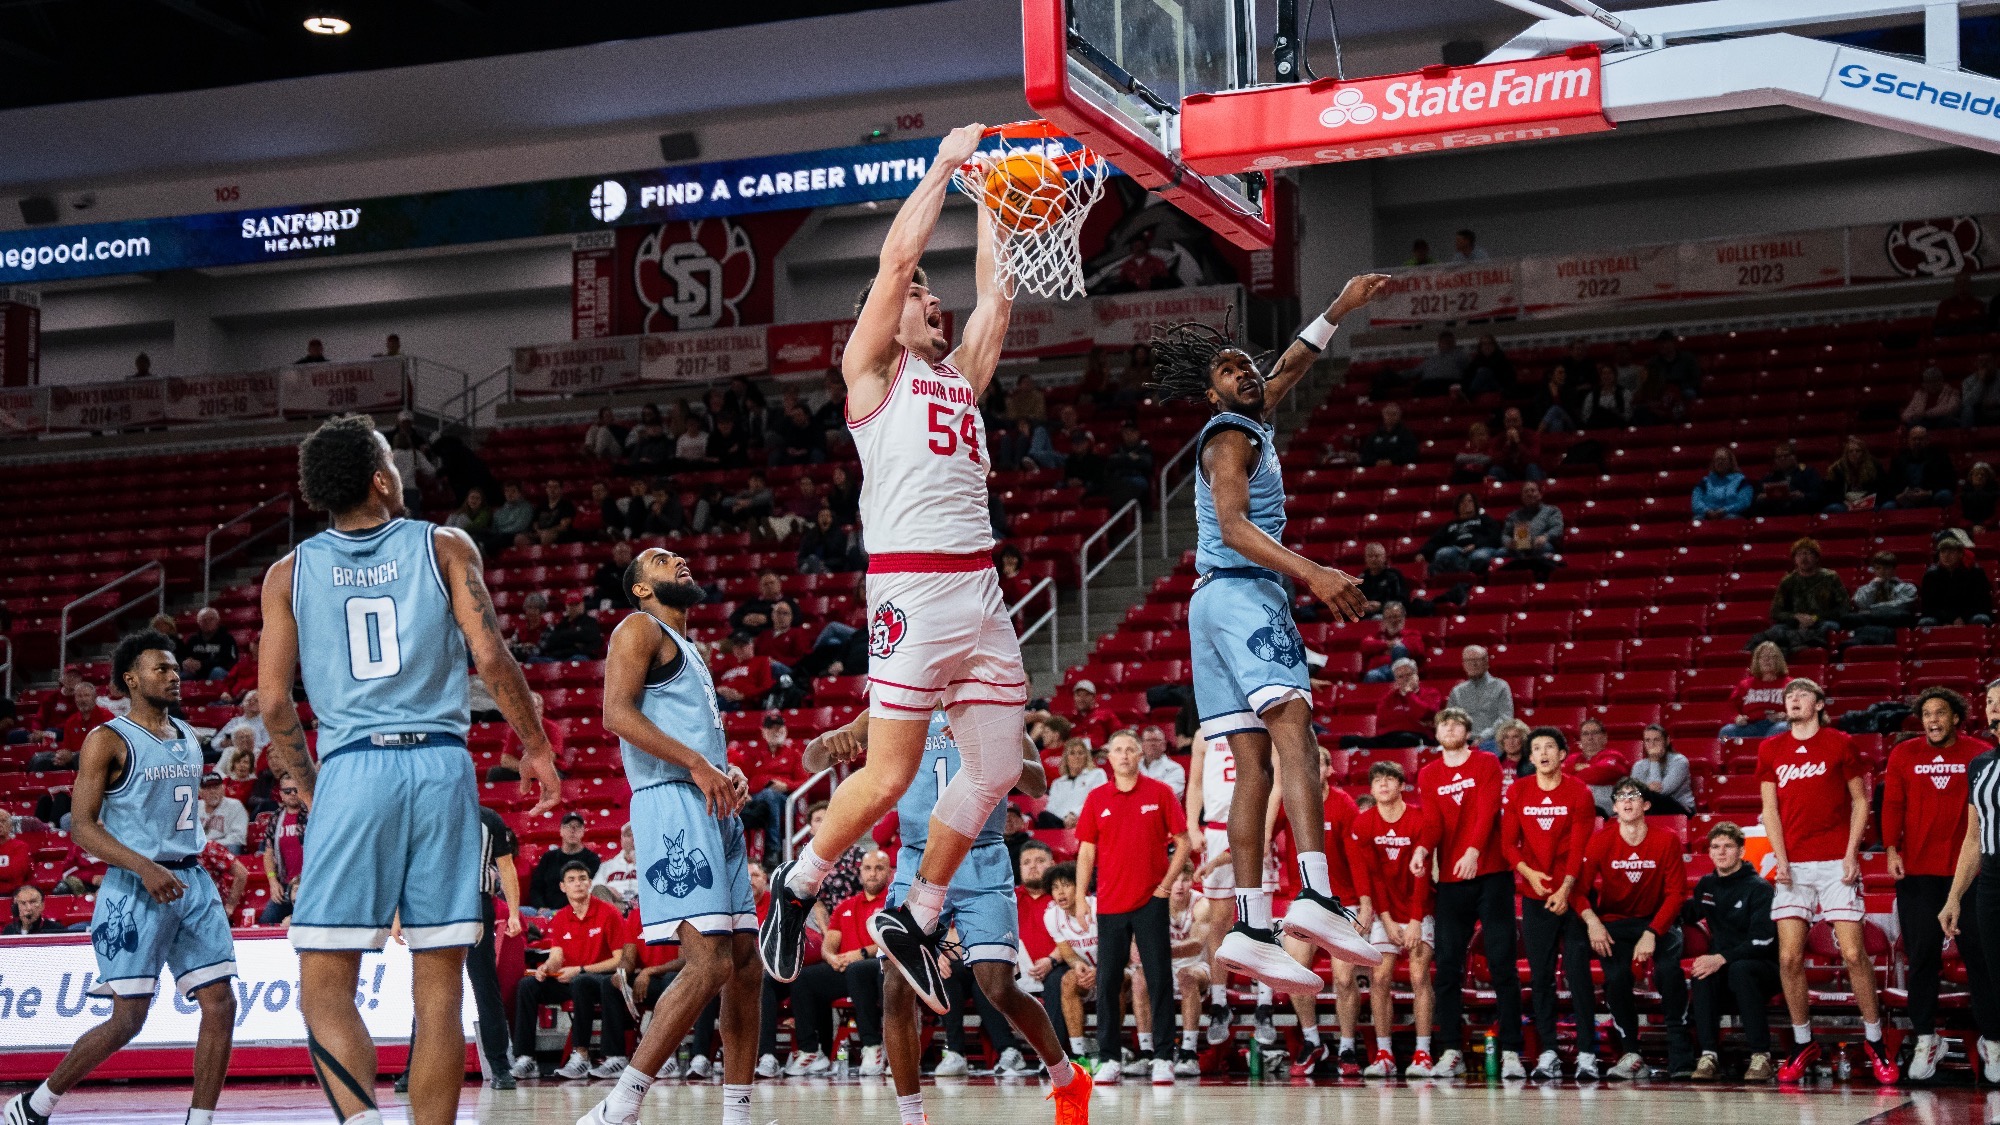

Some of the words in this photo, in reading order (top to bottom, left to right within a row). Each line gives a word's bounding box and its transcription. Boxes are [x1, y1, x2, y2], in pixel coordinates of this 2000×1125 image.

[1382, 76, 1484, 120] State
[1489, 67, 1592, 109] Farm
[896, 113, 925, 130] 106
[641, 179, 702, 208] FIND
[710, 178, 731, 201] A
[738, 166, 845, 196] CAREER
[853, 157, 926, 186] WITH
[215, 186, 240, 202] 105
[242, 208, 359, 239] SANFORD
[264, 233, 336, 253] HEALTH
[1716, 241, 1804, 263] VOLLEYBALL
[1557, 256, 1640, 278] VOLLEYBALL
[1738, 264, 1785, 286] 2023
[1436, 269, 1513, 290] BASKETBALL
[1577, 279, 1622, 299] 2022
[1155, 297, 1226, 315] BASKETBALL
[1411, 292, 1479, 316] 2021-22
[697, 336, 761, 353] BASKETBALL
[563, 347, 625, 366] BASKETBALL
[676, 355, 731, 376] 2017-18
[217, 378, 275, 394] BASKETBALL
[312, 369, 375, 387] VOLLEYBALL
[551, 366, 604, 388] 2016-17
[101, 386, 160, 402] BASKETBALL
[328, 387, 358, 406] 2016
[80, 405, 132, 424] 2014-15
[199, 396, 248, 417] 2015-16
[928, 402, 981, 464] 54
[332, 559, 400, 587] BRANCH
[345, 595, 402, 682] 0
[144, 764, 190, 782] KANSAS
[933, 756, 948, 801] 1
[1775, 761, 1828, 788] Yotes
[1914, 763, 1966, 774] COYOTES
[1437, 778, 1476, 796] COYOTES
[174, 785, 194, 831] 2
[1523, 805, 1569, 816] COYOTES
[1611, 859, 1657, 869] COYOTES
